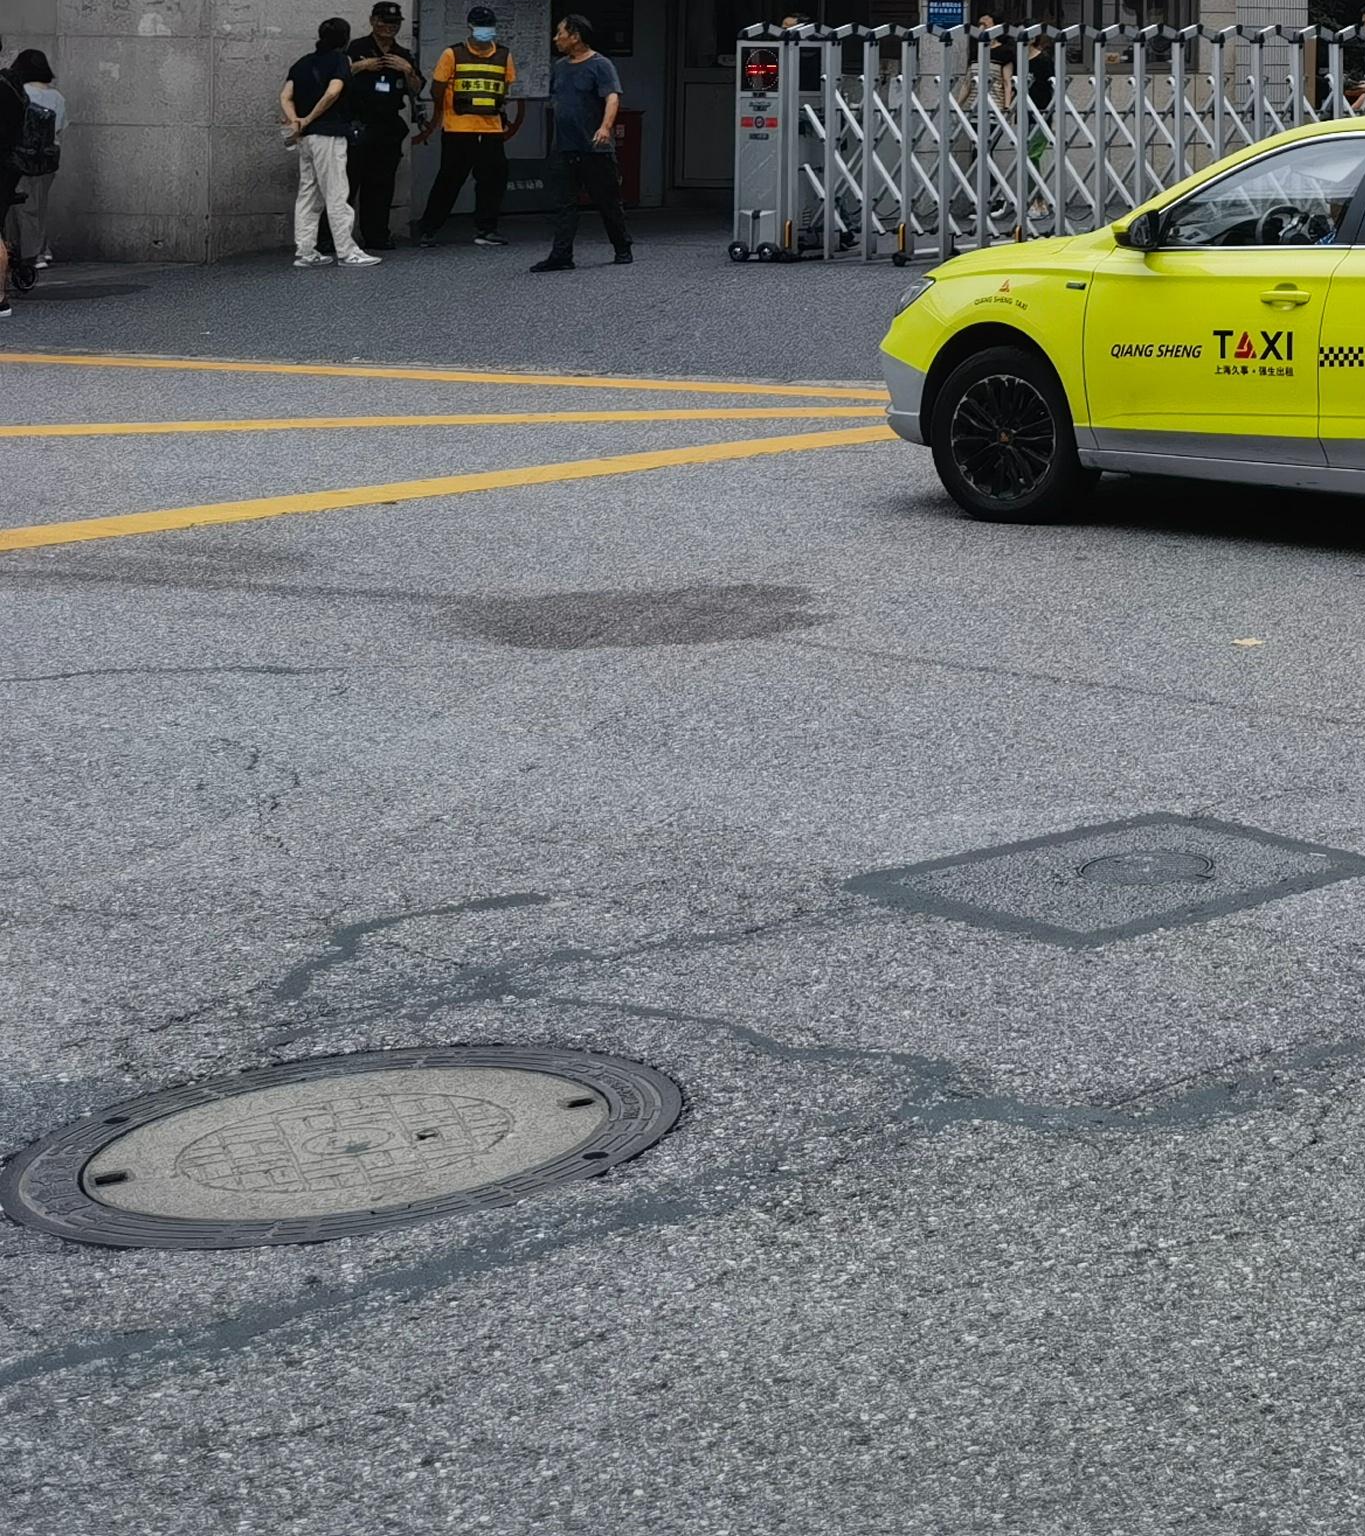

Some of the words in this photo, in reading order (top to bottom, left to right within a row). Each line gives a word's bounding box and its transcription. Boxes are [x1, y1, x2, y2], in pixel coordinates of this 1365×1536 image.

[1110, 343, 1153, 358] QIANG
[1156, 344, 1202, 358] SHENG
[1212, 330, 1294, 361] TAXI
